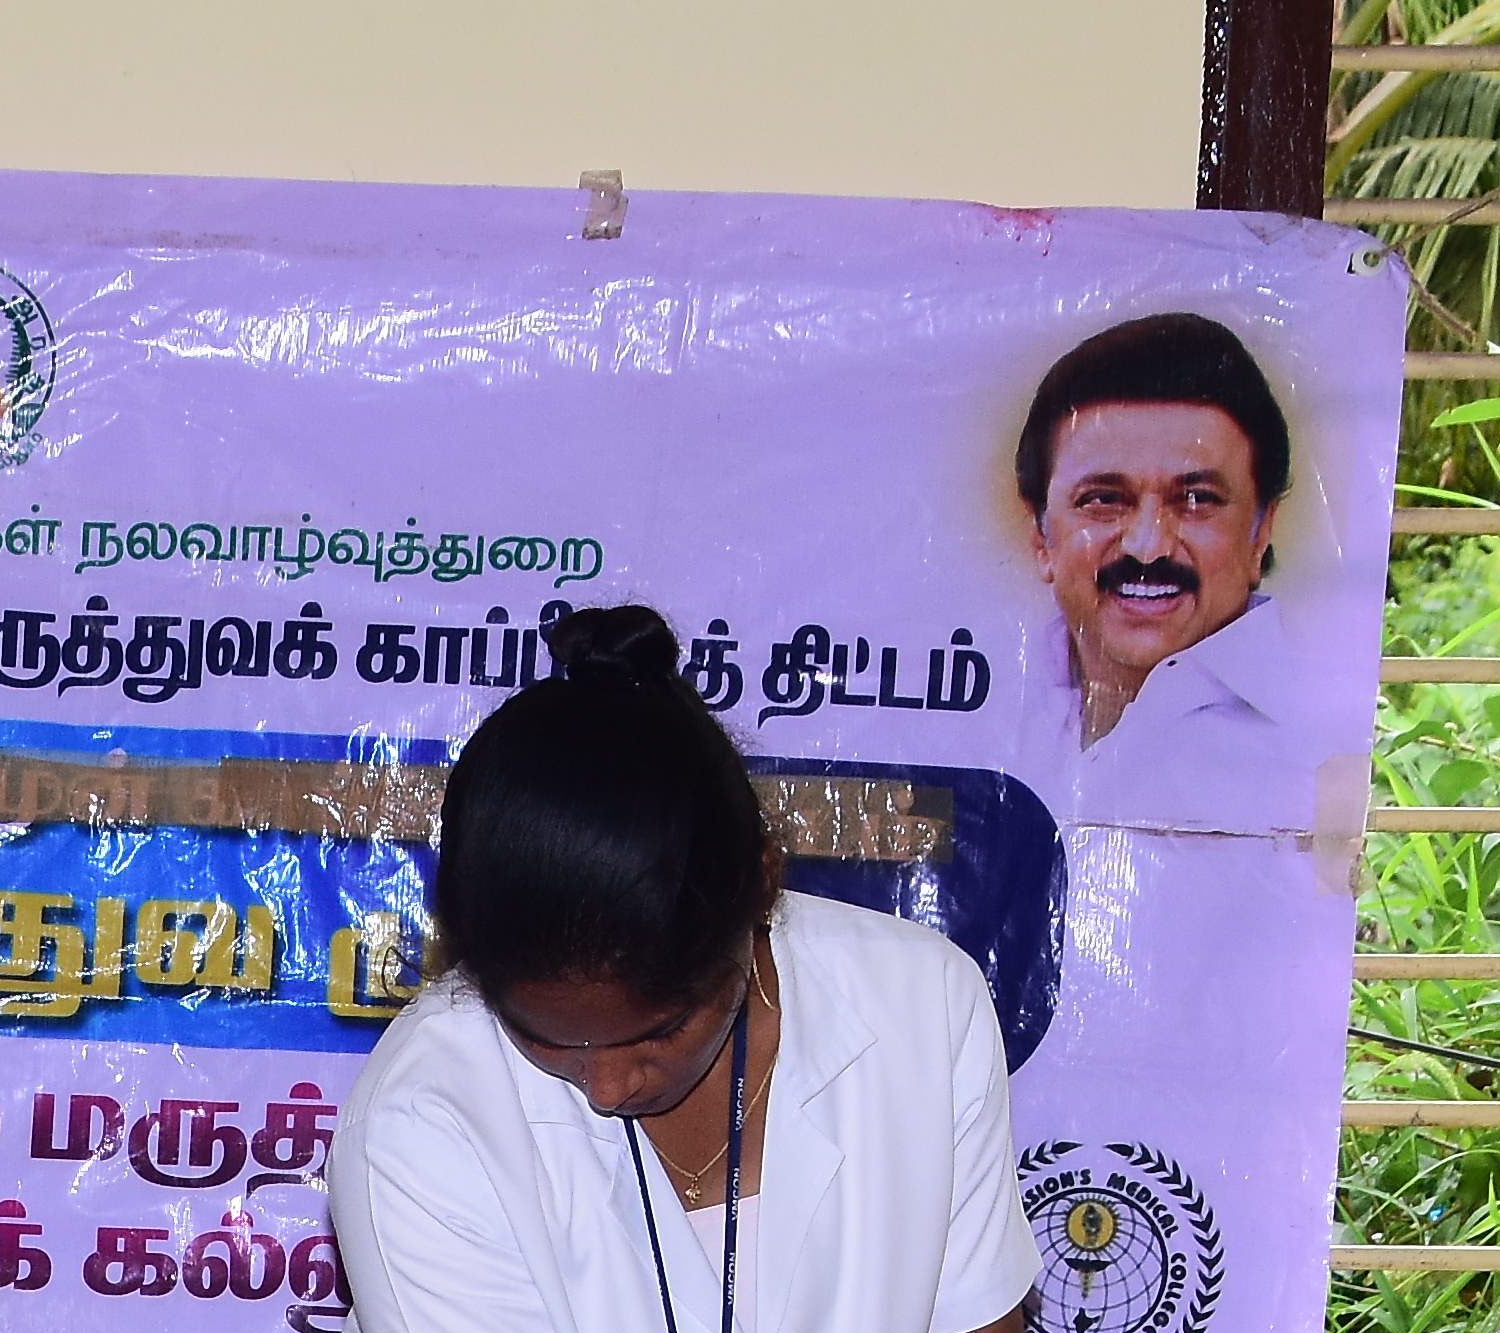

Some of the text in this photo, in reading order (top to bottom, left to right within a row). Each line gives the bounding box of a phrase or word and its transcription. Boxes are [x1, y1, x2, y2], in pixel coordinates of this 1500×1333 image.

[74, 513, 604, 589] நலவாழ்வுத்துறை
[757, 623, 992, 728] திட்டம்
[735, 1077, 745, 1132] VMCON
[731, 1167, 741, 1221] VMCON
[1106, 1172, 1180, 1239] MEDICAL
[727, 1252, 737, 1305] VMCON
